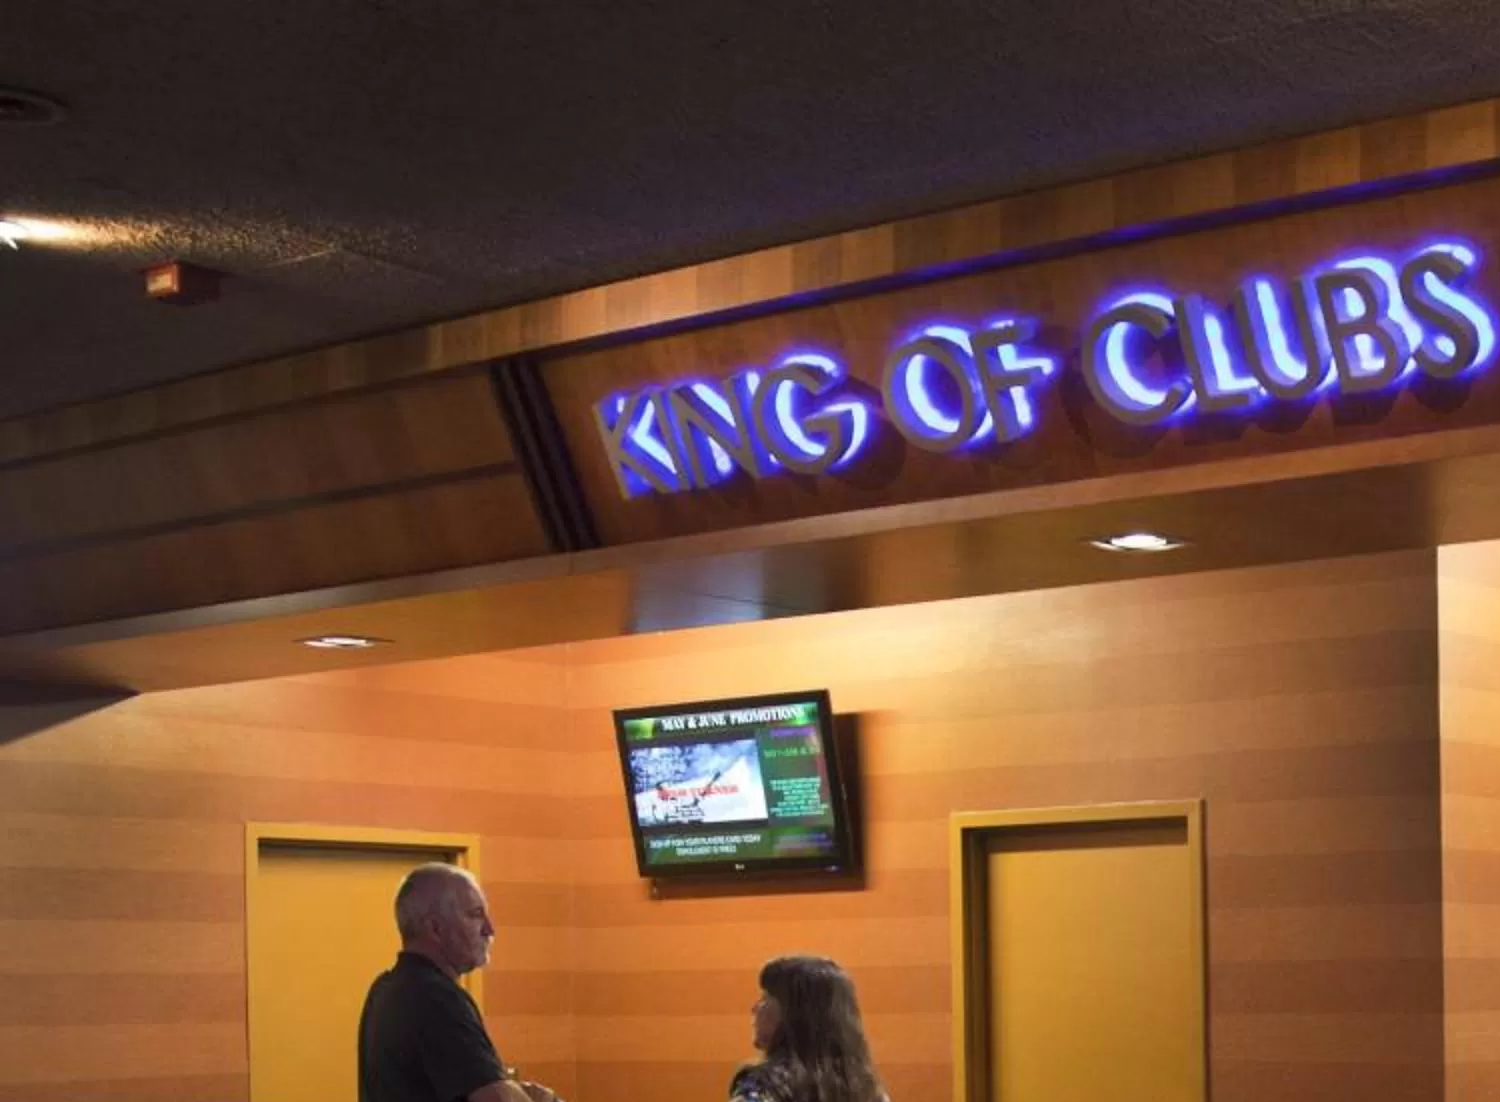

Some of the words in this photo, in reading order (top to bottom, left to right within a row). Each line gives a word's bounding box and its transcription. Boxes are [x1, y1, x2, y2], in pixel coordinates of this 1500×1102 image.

[594, 354, 866, 500] KING
[880, 322, 1054, 454] OF
[1081, 243, 1495, 427] CLUBS
